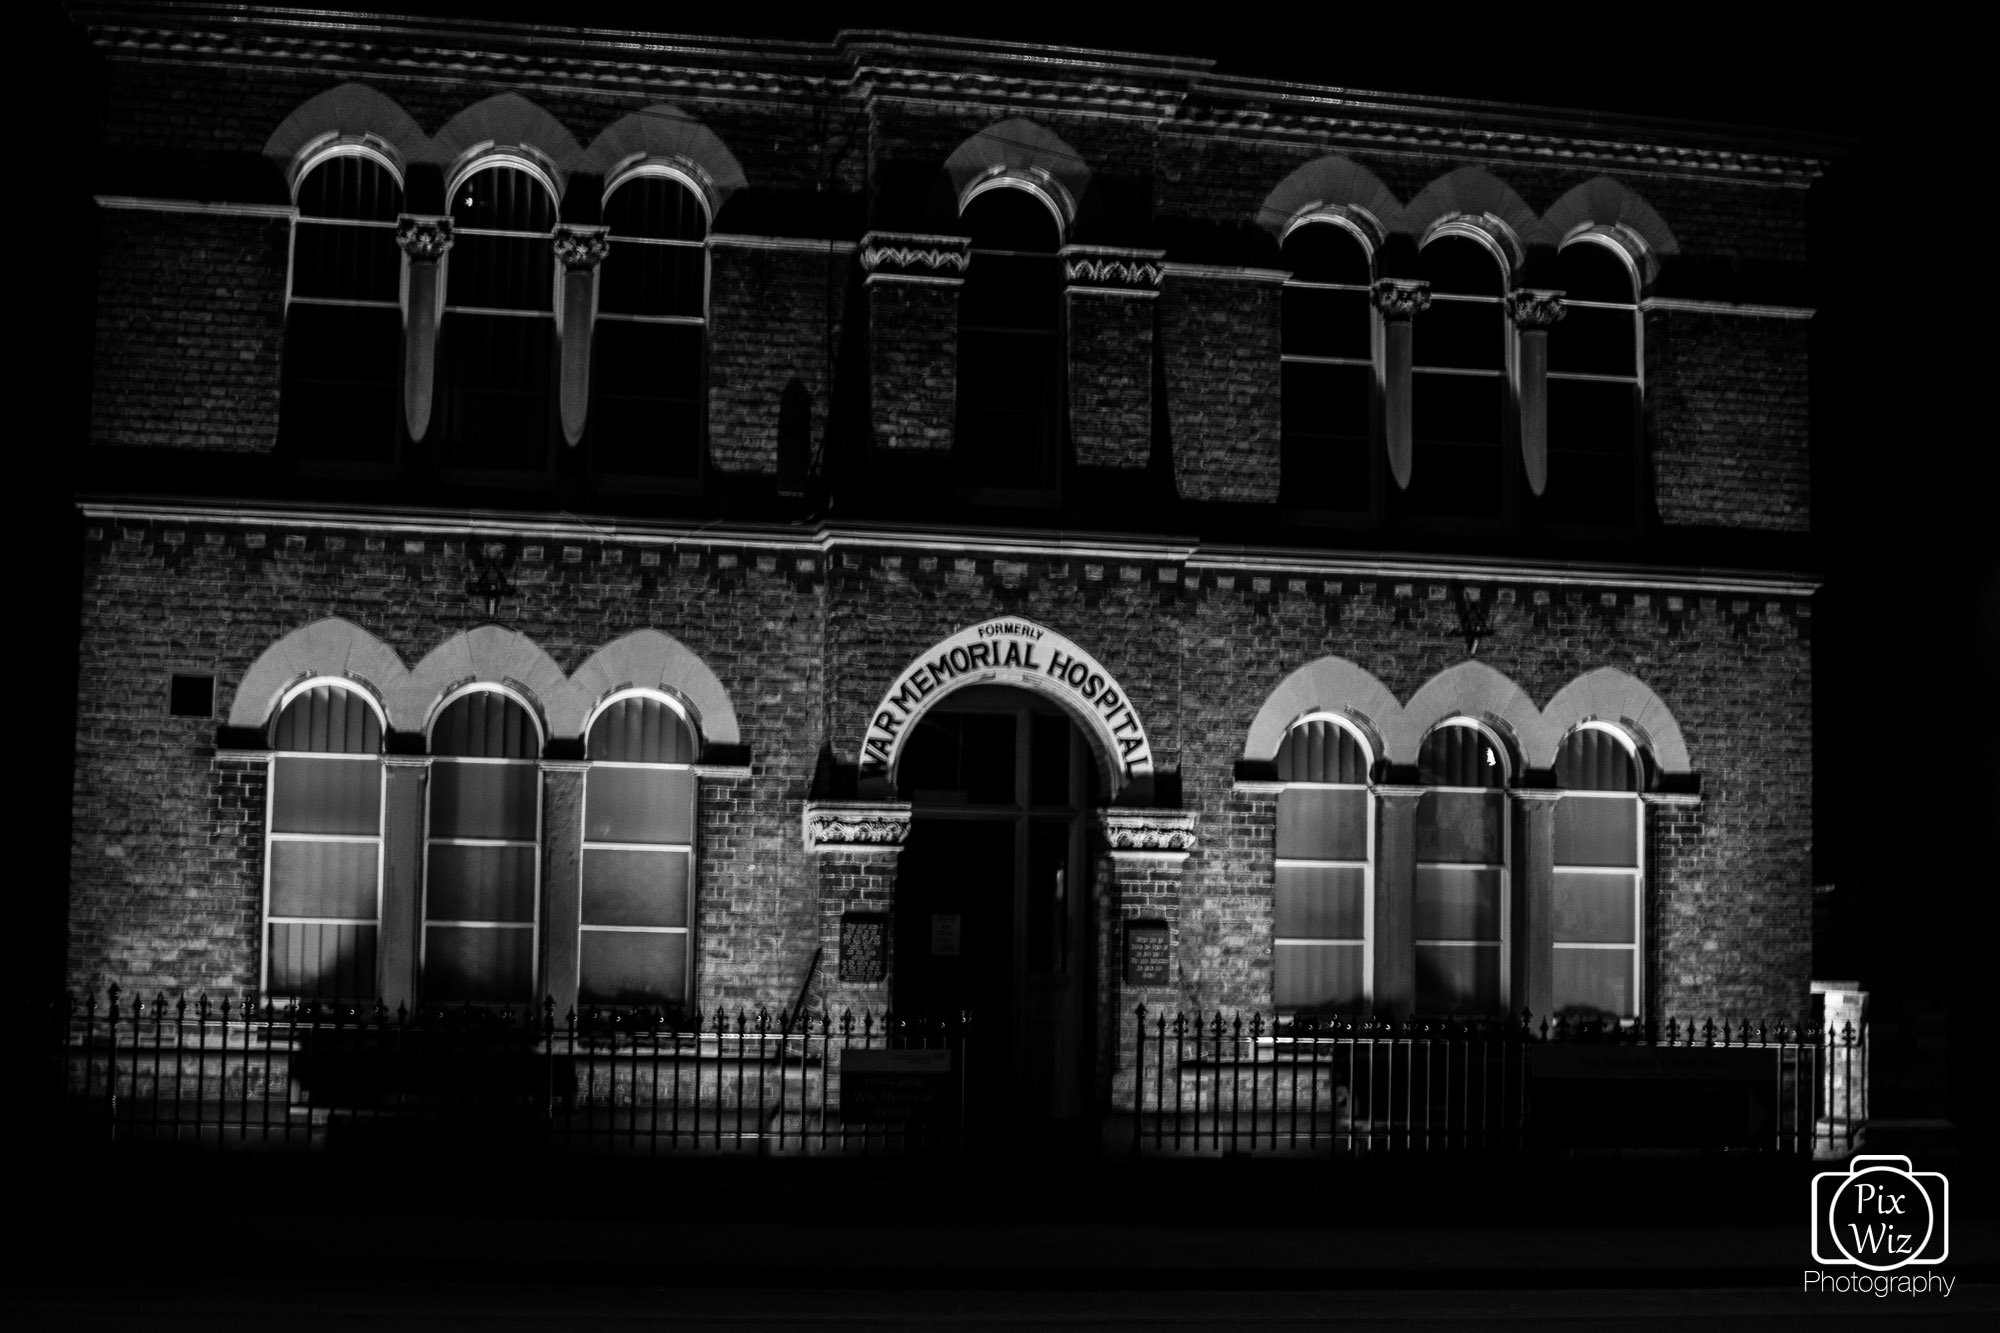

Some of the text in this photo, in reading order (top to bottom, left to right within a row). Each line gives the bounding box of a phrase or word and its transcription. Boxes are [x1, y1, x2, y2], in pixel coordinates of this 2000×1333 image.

[978, 622, 1044, 641] FORMERLY
[860, 642, 1151, 781] WAR MEMORIAL HOSPITAL
